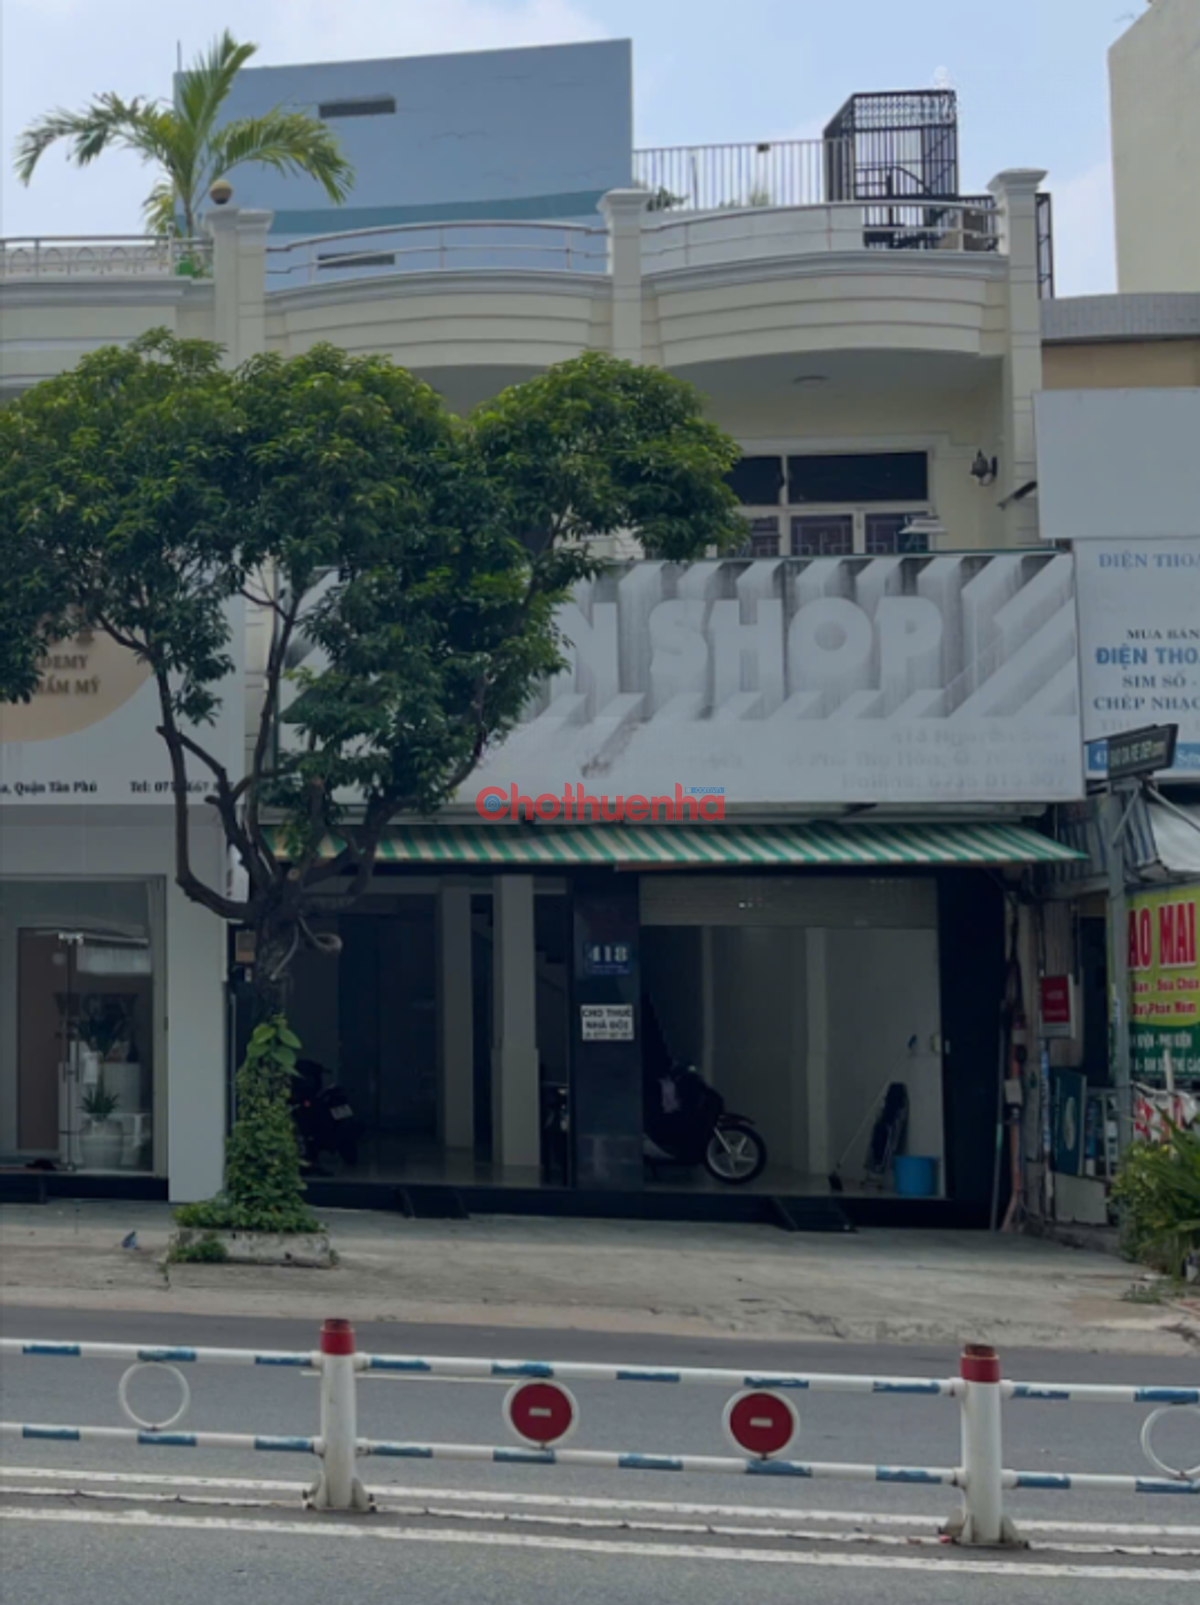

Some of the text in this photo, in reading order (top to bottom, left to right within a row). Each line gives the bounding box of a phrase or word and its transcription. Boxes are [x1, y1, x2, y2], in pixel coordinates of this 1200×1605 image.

[648, 594, 942, 690] SHOP
[1126, 629, 1162, 640] MUA
[1096, 644, 1200, 670] ĐIỆN THO
[1122, 675, 1156, 688] SIM
[73, 780, 97, 793] Phú
[1159, 902, 1196, 967] MAI
[587, 945, 628, 962] 418
